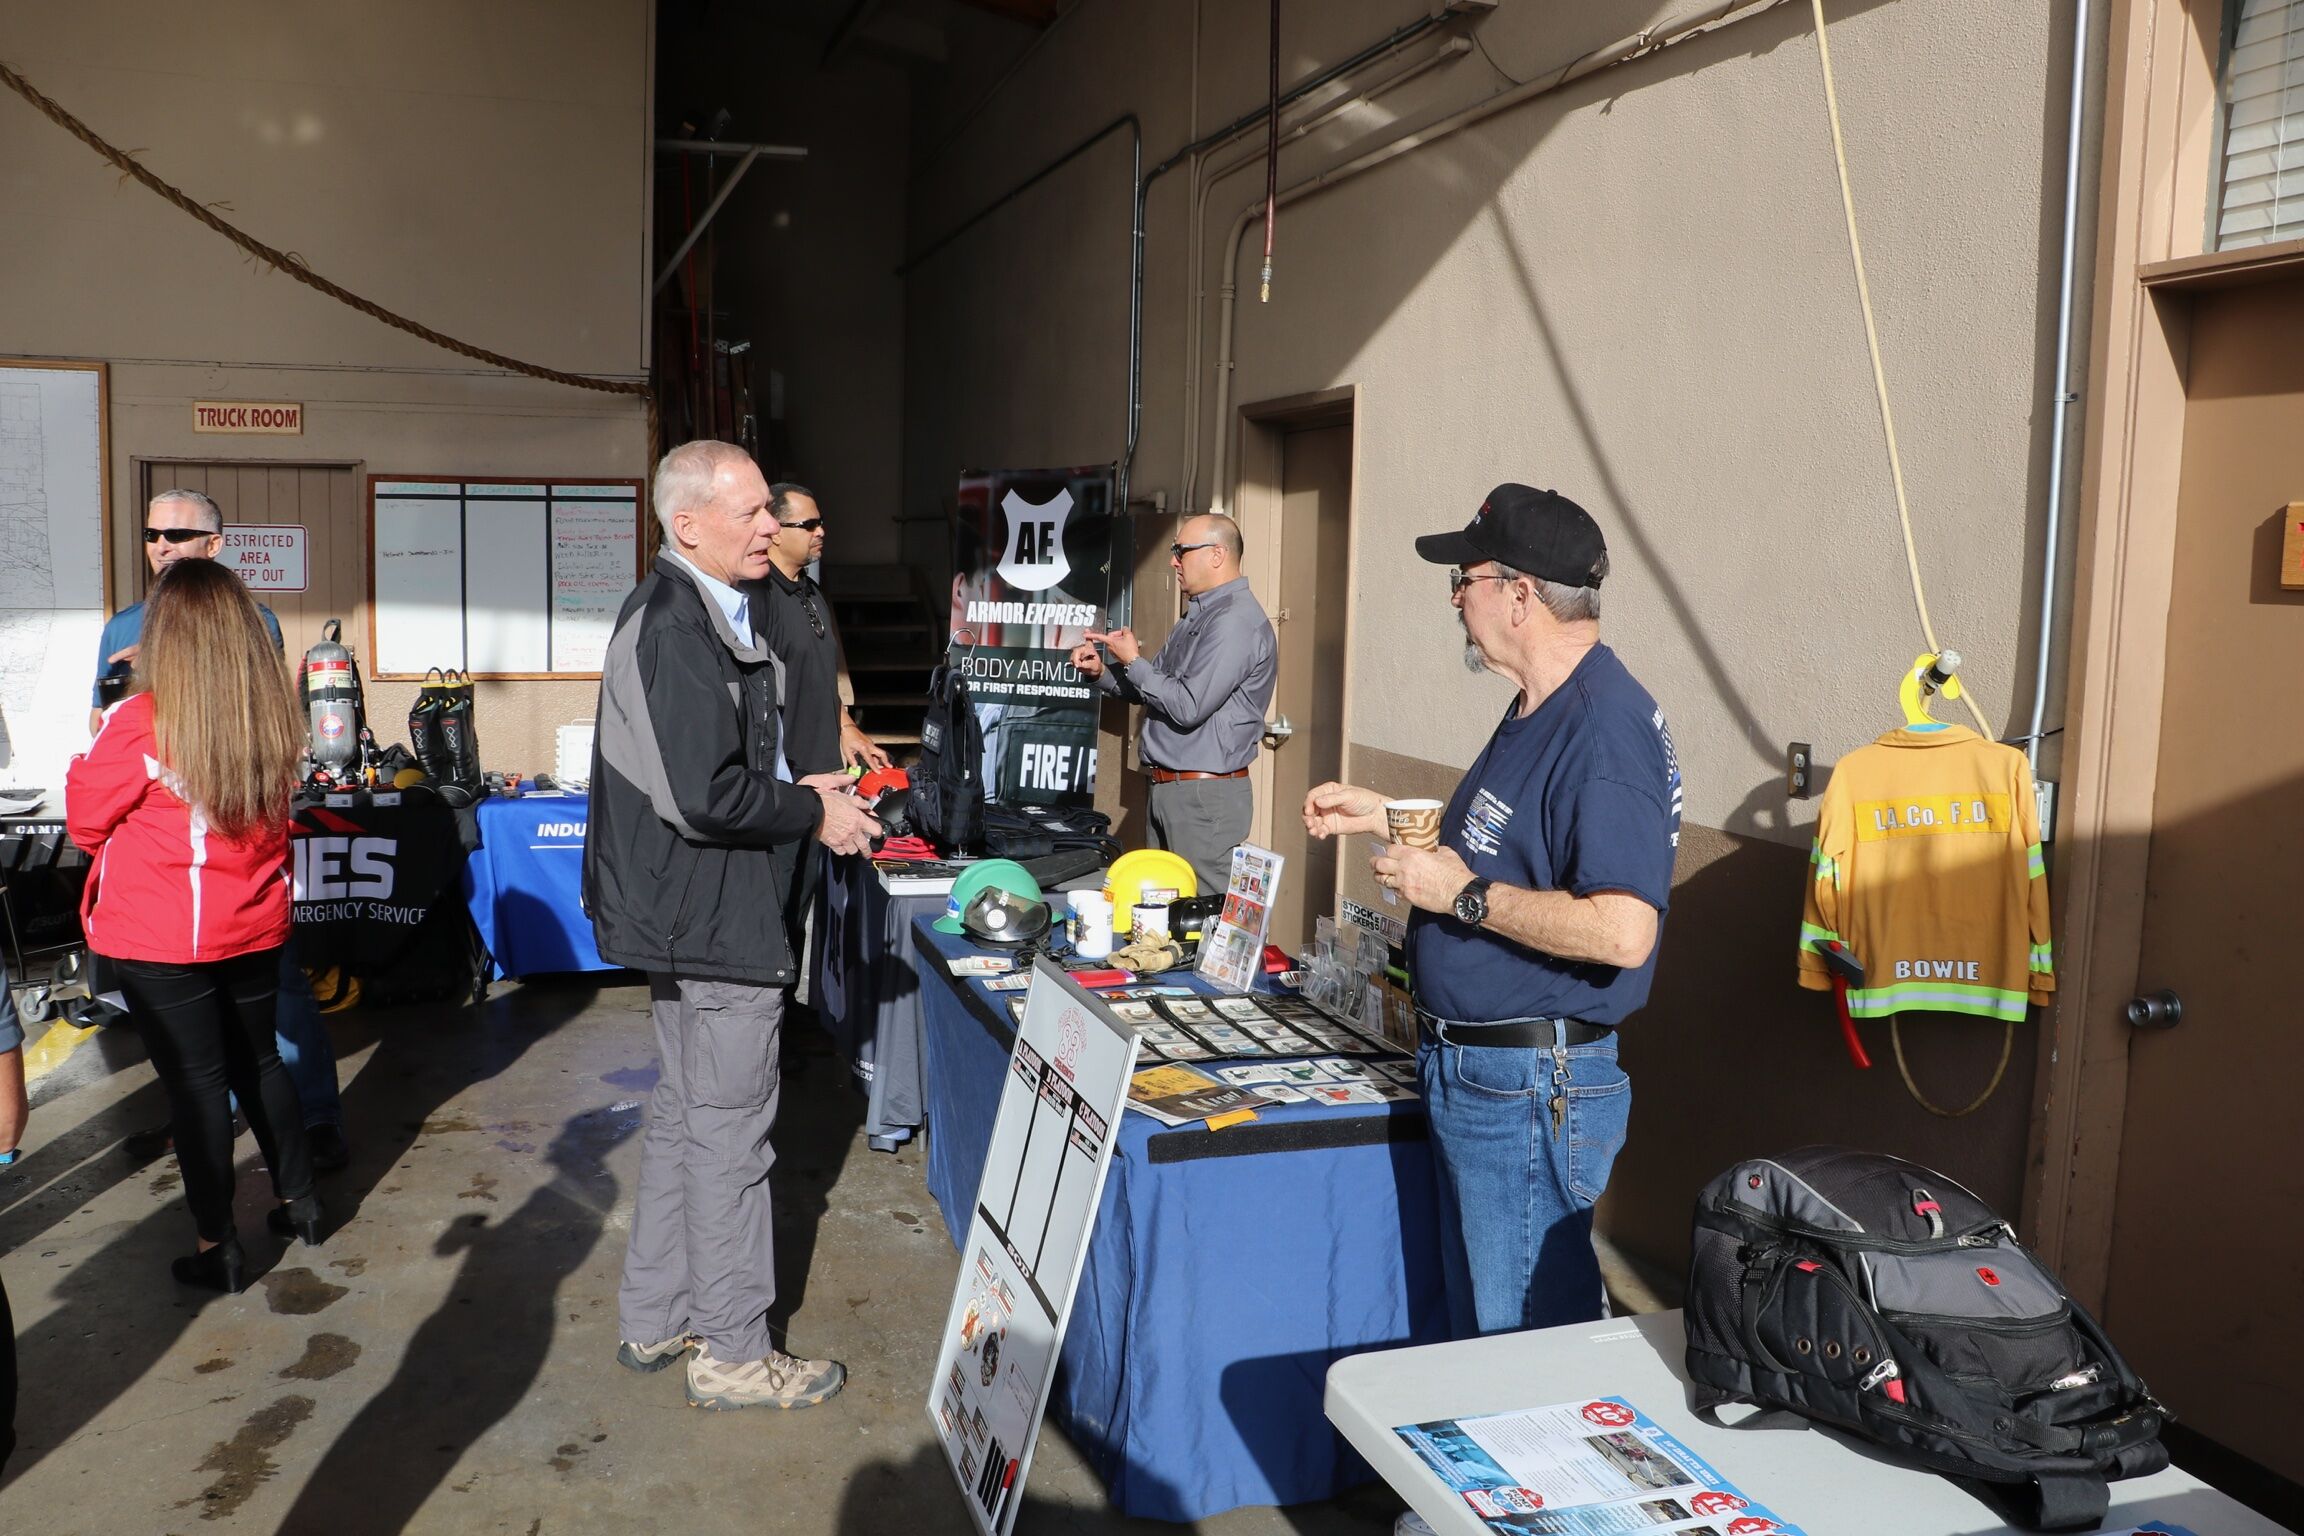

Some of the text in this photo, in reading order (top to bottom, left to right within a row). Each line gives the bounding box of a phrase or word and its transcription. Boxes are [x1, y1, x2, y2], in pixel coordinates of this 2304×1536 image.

[198, 408, 297, 428] TRUCK ROOM
[225, 534, 294, 547] ESTRICTED
[1014, 522, 1055, 565] AE
[239, 552, 271, 564] AREA
[234, 569, 285, 582] EEP OUT
[966, 601, 1097, 627] ARMOR EXPRESS
[961, 657, 1014, 679] BODY
[967, 681, 1090, 699] OR FIRST RESPONDERS
[1020, 744, 1071, 791] FIRE
[15, 825, 63, 834] CAMP
[293, 837, 397, 901] ES
[1342, 900, 1375, 921] STOCK
[1342, 911, 1375, 931] STICKERS
[1895, 960, 1979, 980] BOWIE
[1058, 1024, 1080, 1068] 83
[1023, 1043, 1042, 1073] PLATOON
[1052, 1074, 1074, 1104] PLATOON
[1083, 1106, 1107, 1141] PLATOON
[1006, 1243, 1030, 1278] SOD
[1509, 1489, 1534, 1510] PUMP
